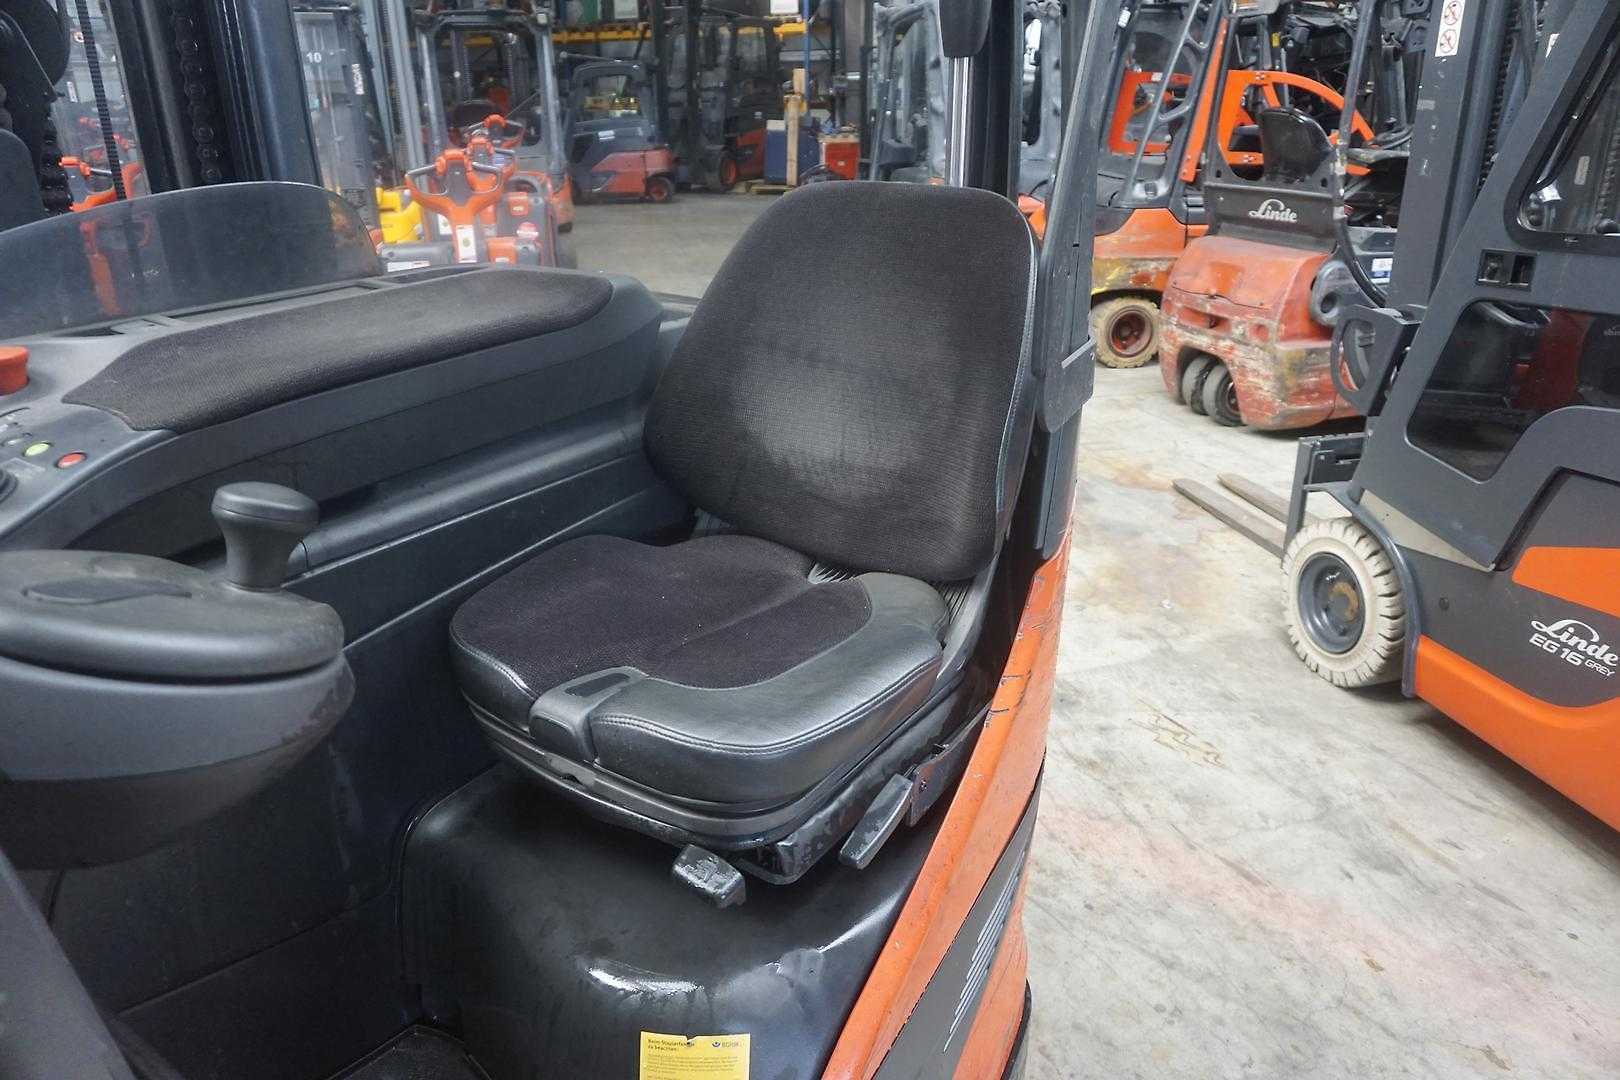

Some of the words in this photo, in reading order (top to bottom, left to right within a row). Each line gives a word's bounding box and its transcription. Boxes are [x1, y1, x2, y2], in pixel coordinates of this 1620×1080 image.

[306, 52, 322, 63] 10
[1249, 199, 1297, 222] Linde
[1529, 633, 1560, 653] EG
[1560, 648, 1585, 666] 16
[1585, 659, 1615, 677] GREY
[1531, 619, 1618, 666] Linde
